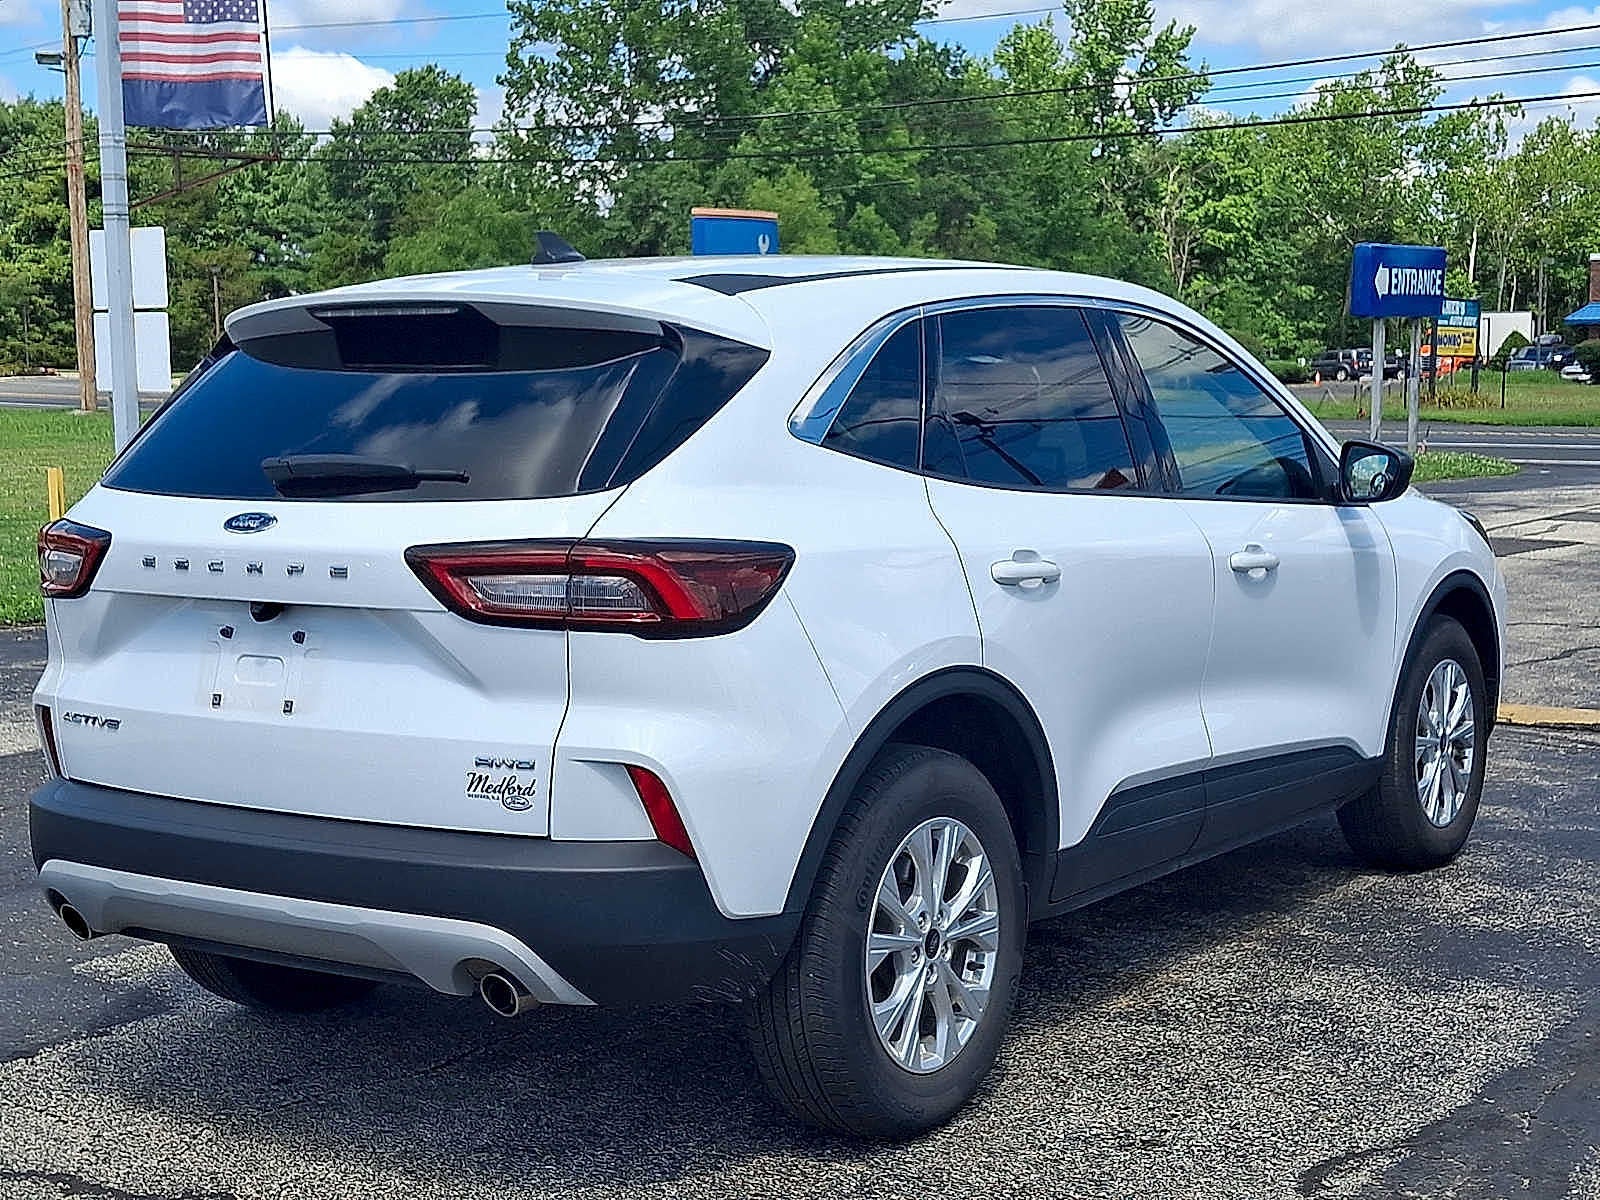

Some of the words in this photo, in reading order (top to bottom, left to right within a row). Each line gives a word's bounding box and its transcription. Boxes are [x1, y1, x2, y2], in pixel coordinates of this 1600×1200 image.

[1391, 268, 1442, 295] ENTRANCE
[142, 556, 348, 578] ESCAPE
[63, 712, 121, 729] ACTIVE
[467, 772, 536, 811] Medford
